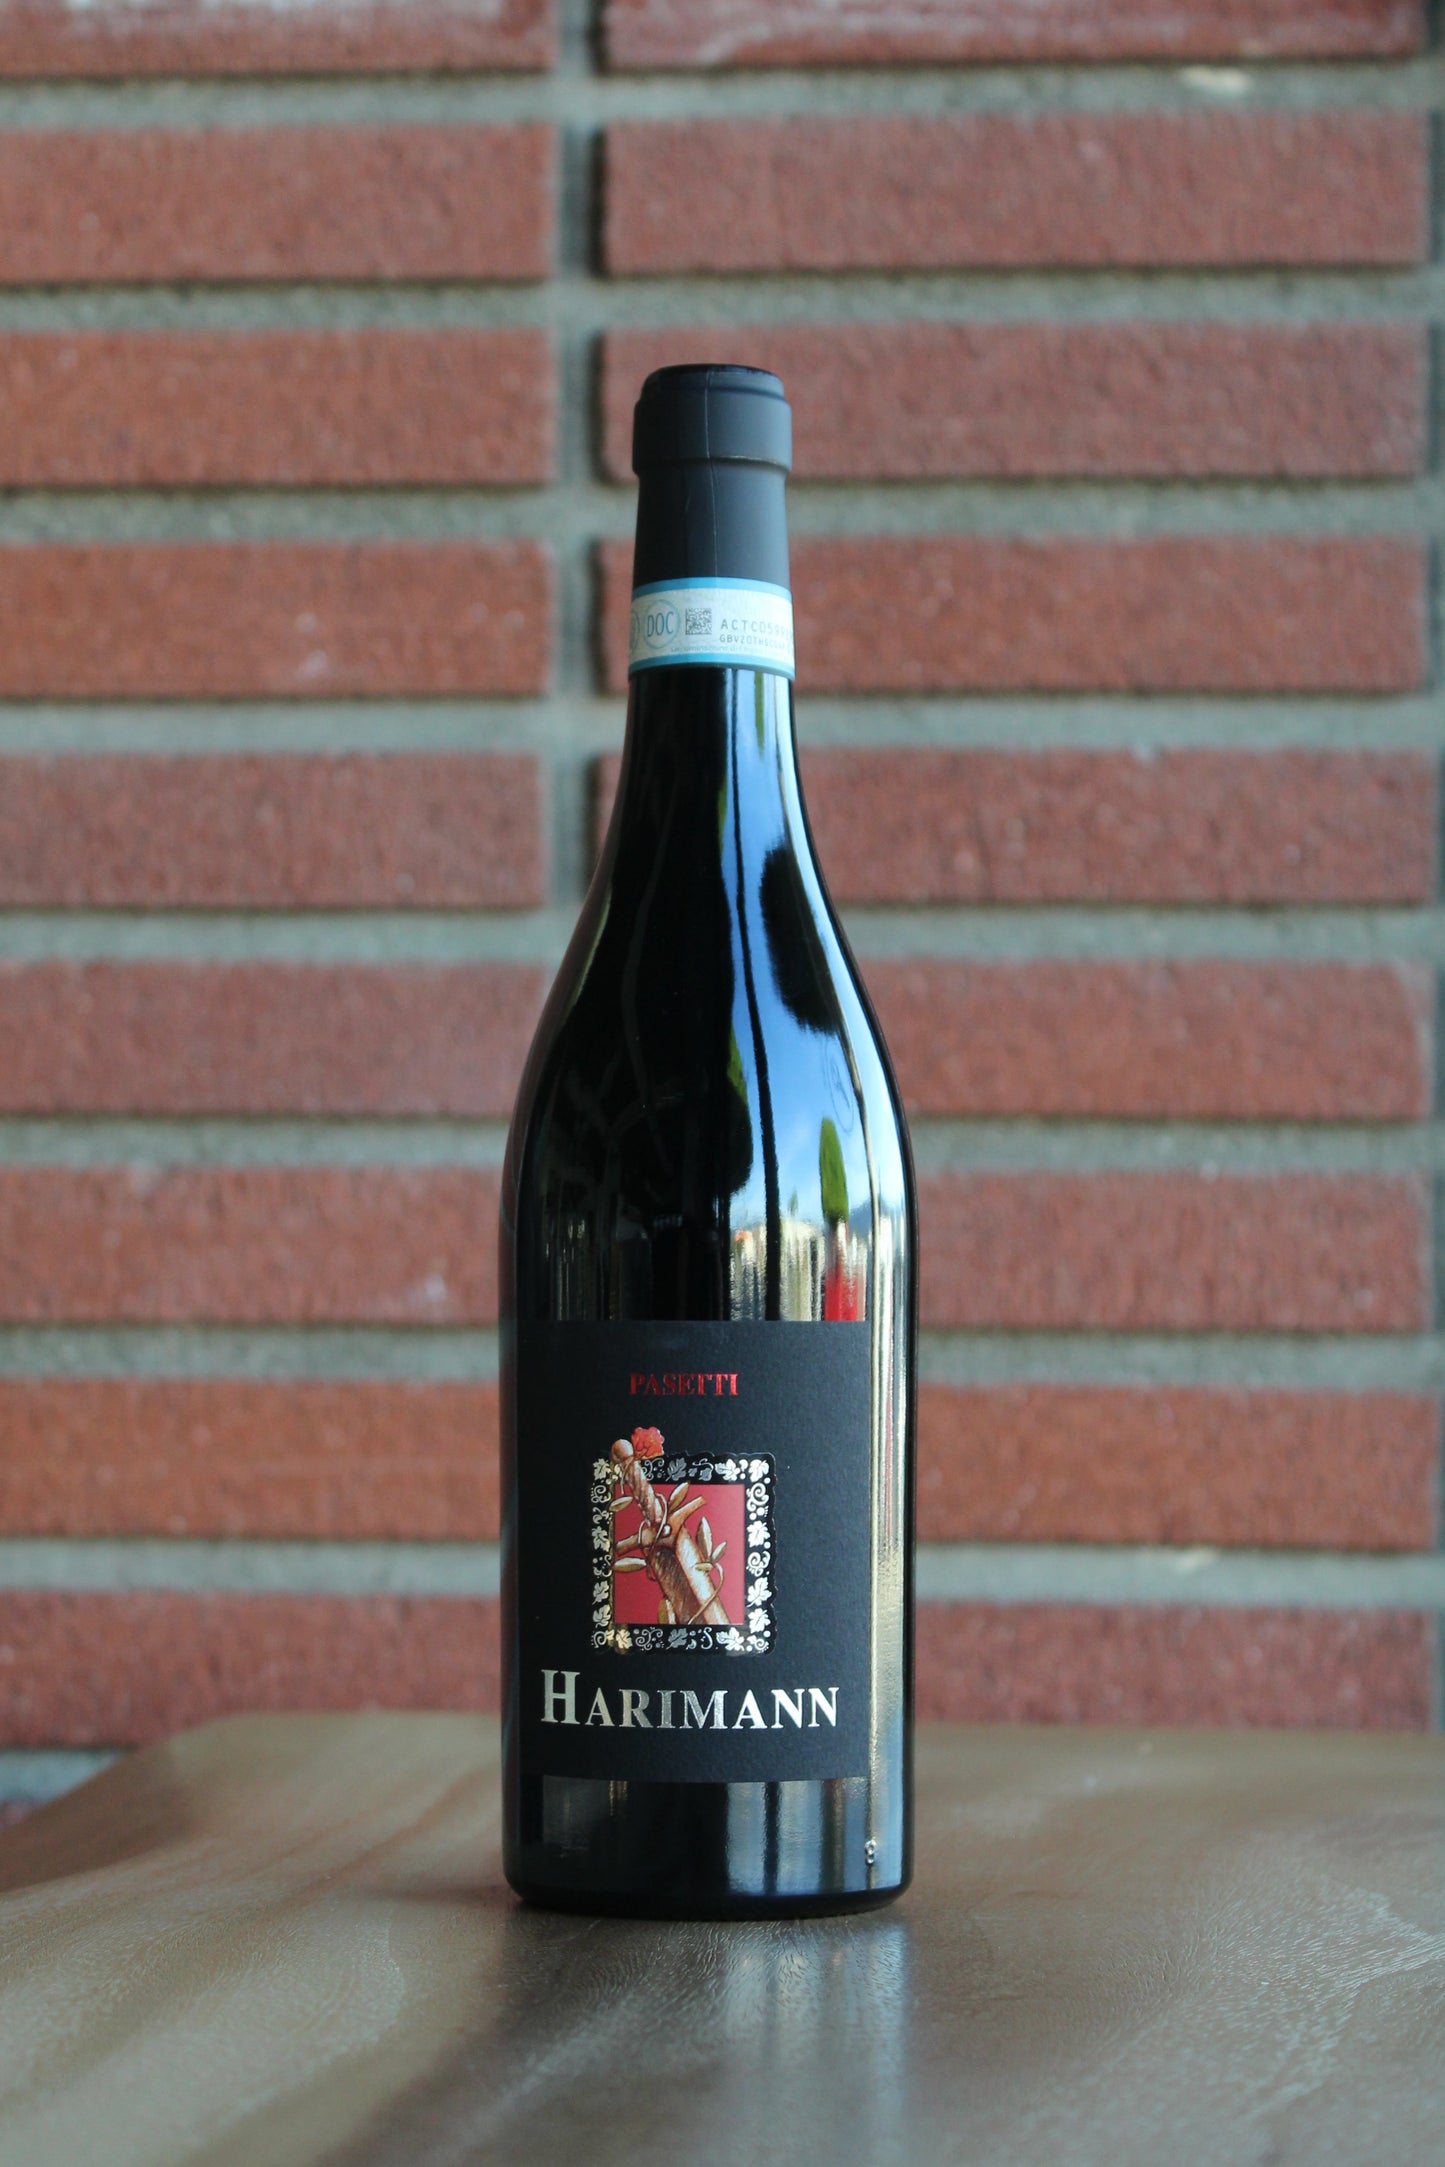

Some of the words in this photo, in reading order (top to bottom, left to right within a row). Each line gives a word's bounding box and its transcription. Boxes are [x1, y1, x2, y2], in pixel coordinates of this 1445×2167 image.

[647, 611, 674, 637] DOC
[629, 1373, 739, 1396] PASETTI
[540, 1669, 840, 1730] HARIMANN
